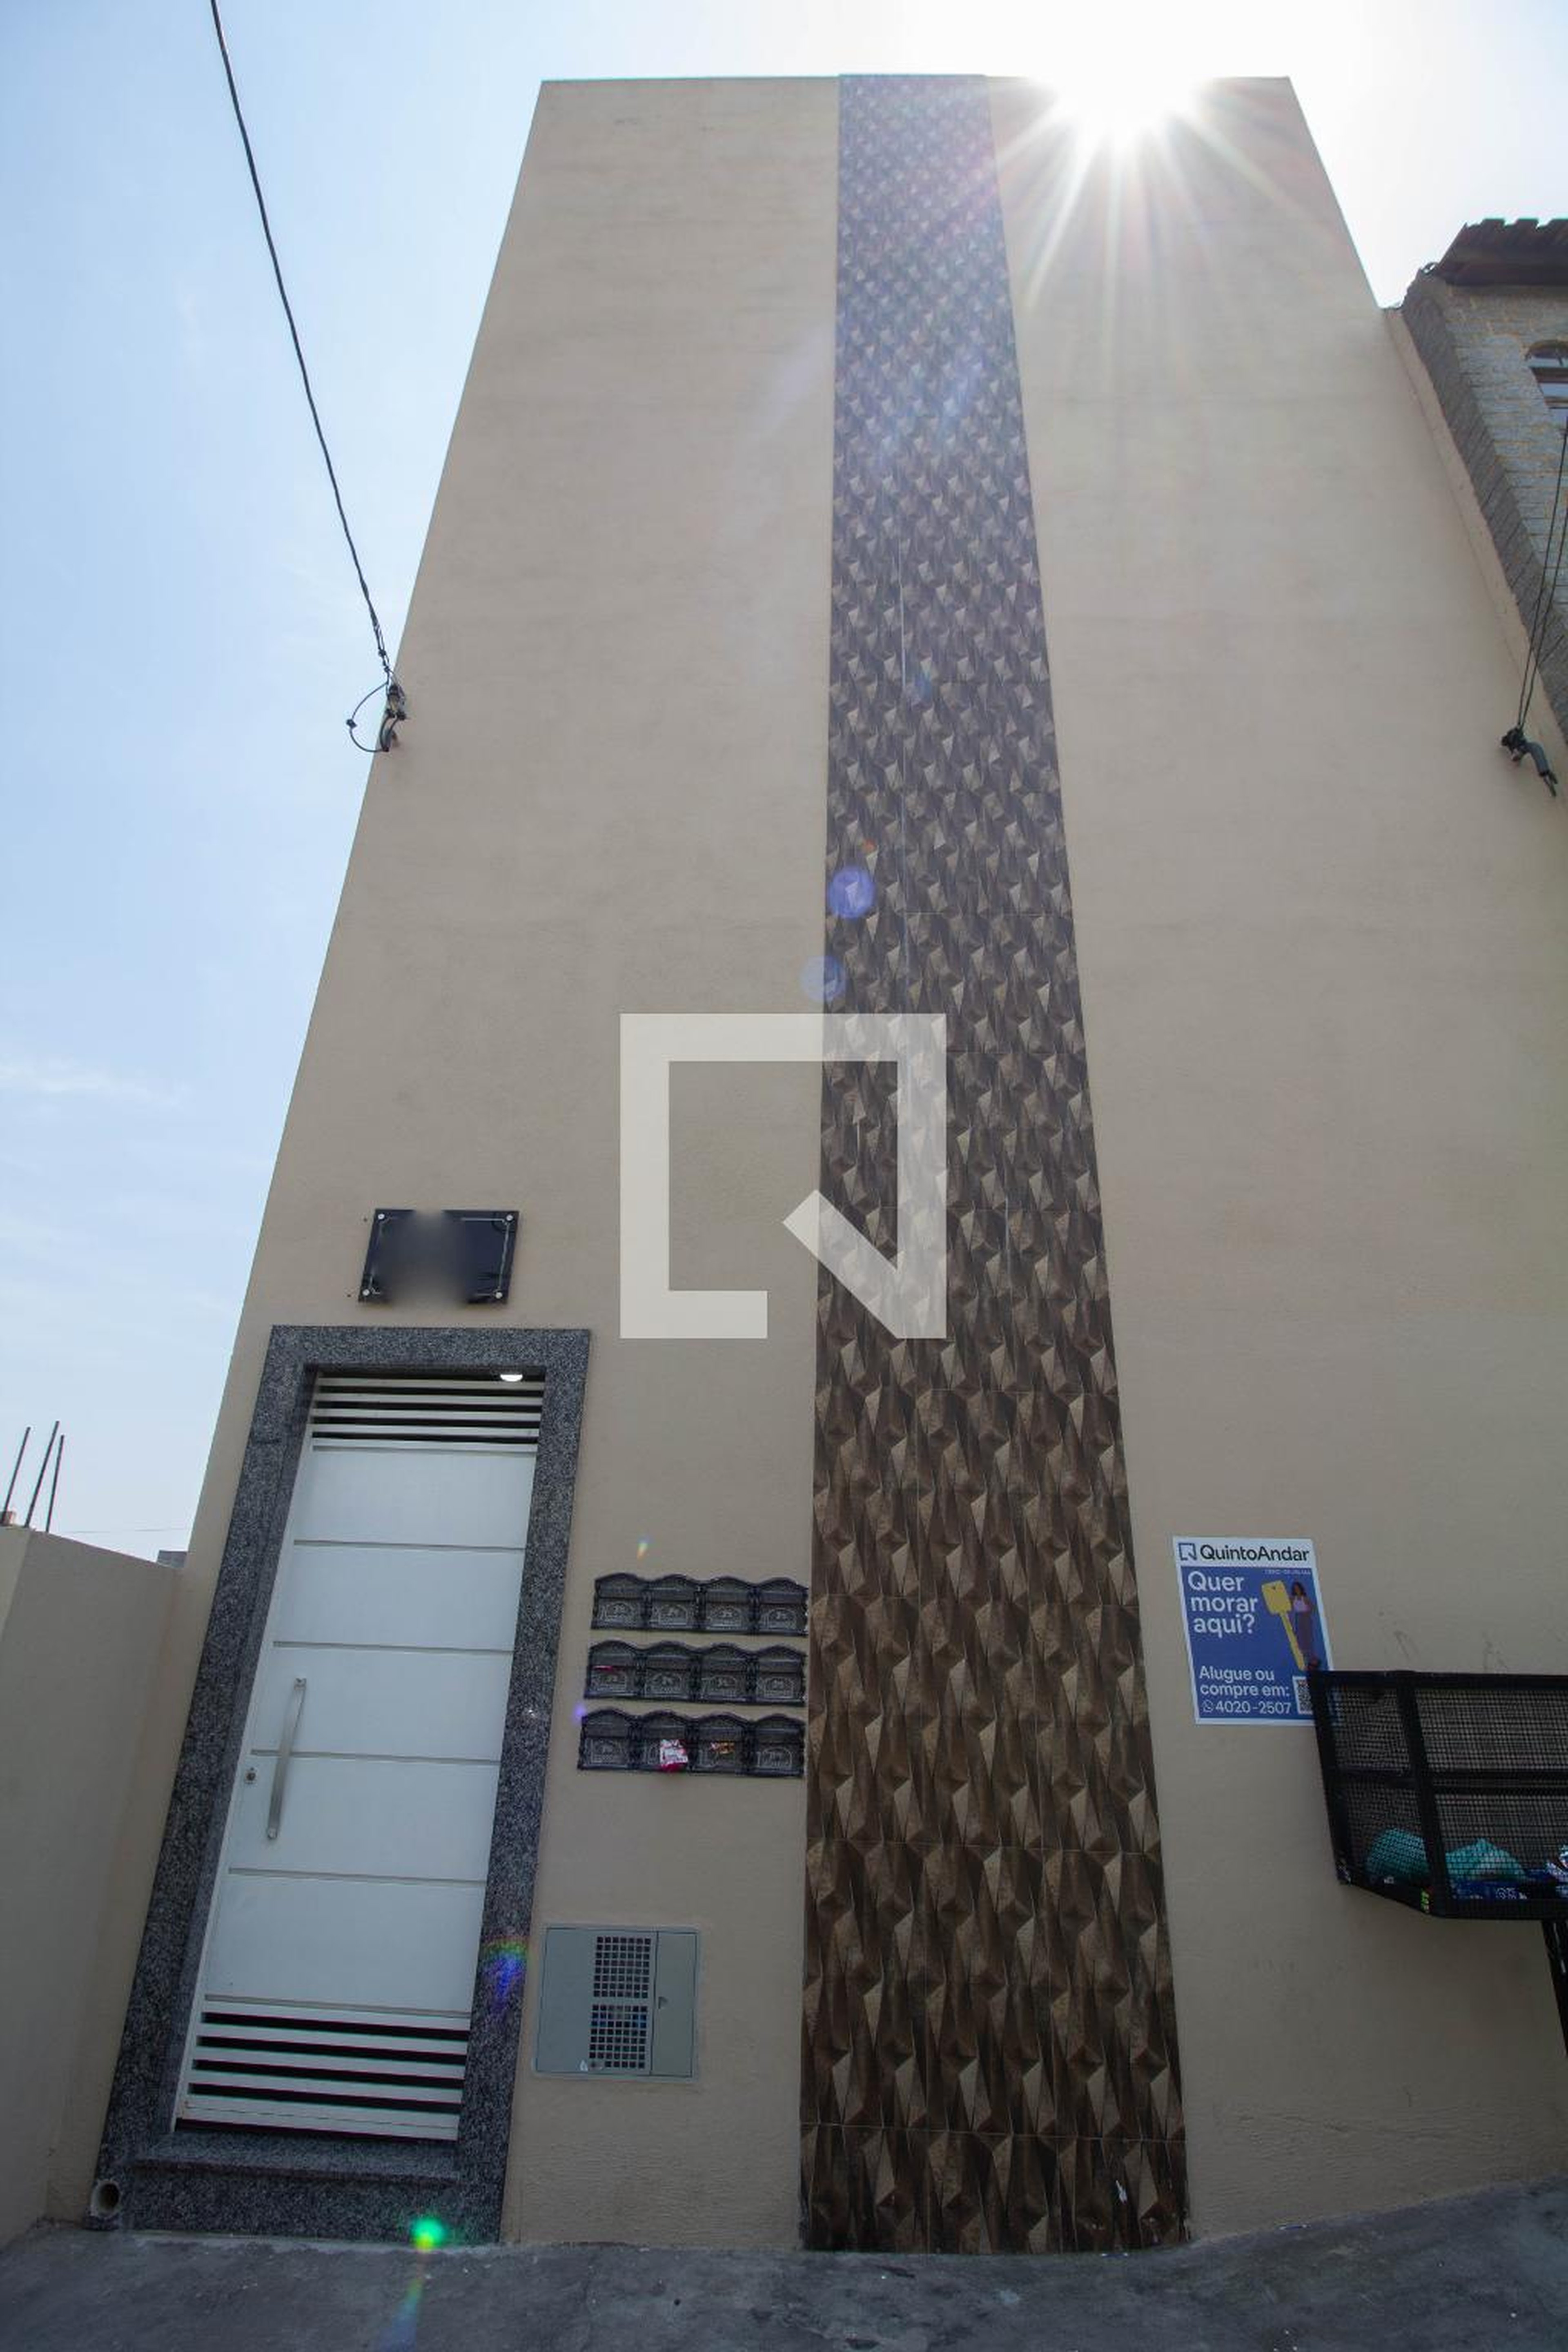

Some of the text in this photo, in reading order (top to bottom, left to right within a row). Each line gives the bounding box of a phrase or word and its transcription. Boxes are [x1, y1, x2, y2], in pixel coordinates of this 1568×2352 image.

[1200, 1544, 1310, 1561] QuintoAndar
[1188, 1571, 1244, 1592] Quer
[1191, 1595, 1258, 1613] morar
[1194, 1614, 1256, 1638] aqui?
[1199, 1666, 1275, 1683] Alugue ou
[1200, 1682, 1290, 1698] compre em:
[1216, 1700, 1291, 1714] 4020-2507
